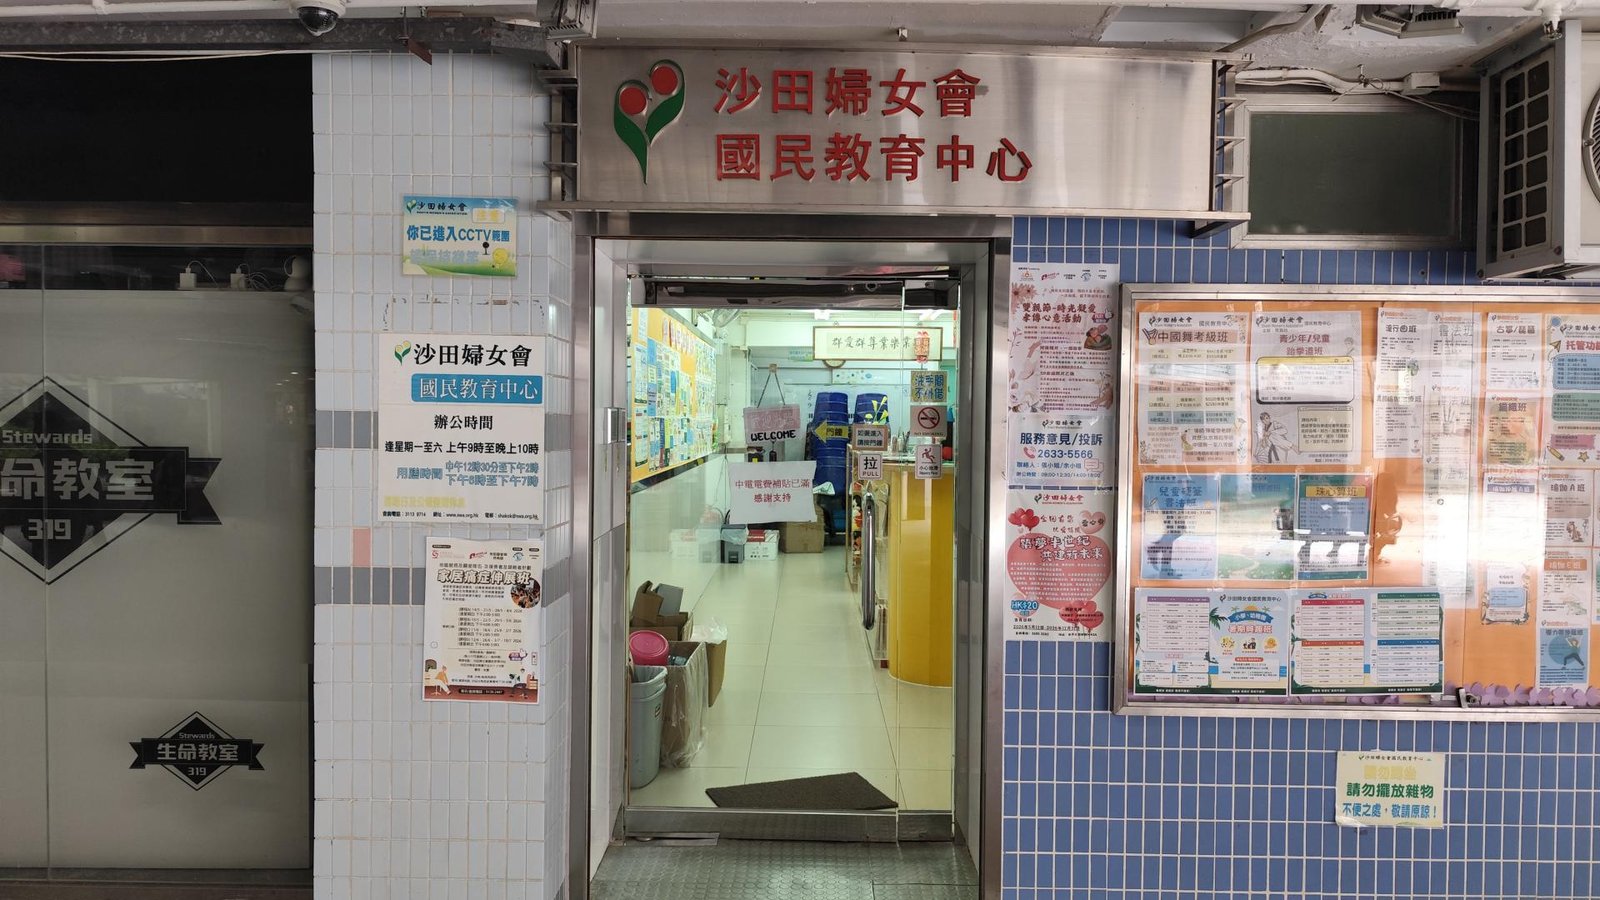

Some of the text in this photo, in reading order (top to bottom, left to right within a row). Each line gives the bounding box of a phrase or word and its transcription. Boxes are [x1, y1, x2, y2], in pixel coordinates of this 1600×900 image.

[714, 67, 981, 118] 沙田婦女會
[716, 132, 1033, 183] 國民教育中心
[406, 224, 510, 242] 你已進入CCTV範圍
[1157, 331, 1229, 343] 中國舞考級班
[1279, 334, 1330, 344] 青少年/兒童
[414, 343, 533, 368] 沙田婦女會
[419, 377, 539, 400] 國民教育中心
[434, 414, 494, 431] 辦公時間
[1, 428, 93, 446] Stewards
[750, 429, 797, 442] WELCOME
[1019, 432, 1103, 446] 服務意見/投訴
[385, 440, 539, 455] 逢星期一至六 上午9時至晚上10時
[863, 456, 878, 470] 拉
[735, 479, 811, 489] 中電電費補貼已滿
[753, 493, 791, 503] 感謝支持
[27, 519, 72, 541] 319
[436, 568, 531, 585] 家居痛症伸展班
[156, 743, 240, 762] 生命教室
[187, 766, 207, 777] 319
[1346, 782, 1434, 799] 請勿擺放雜物
[1342, 802, 1437, 819] 不便之處，敬請原諒！
